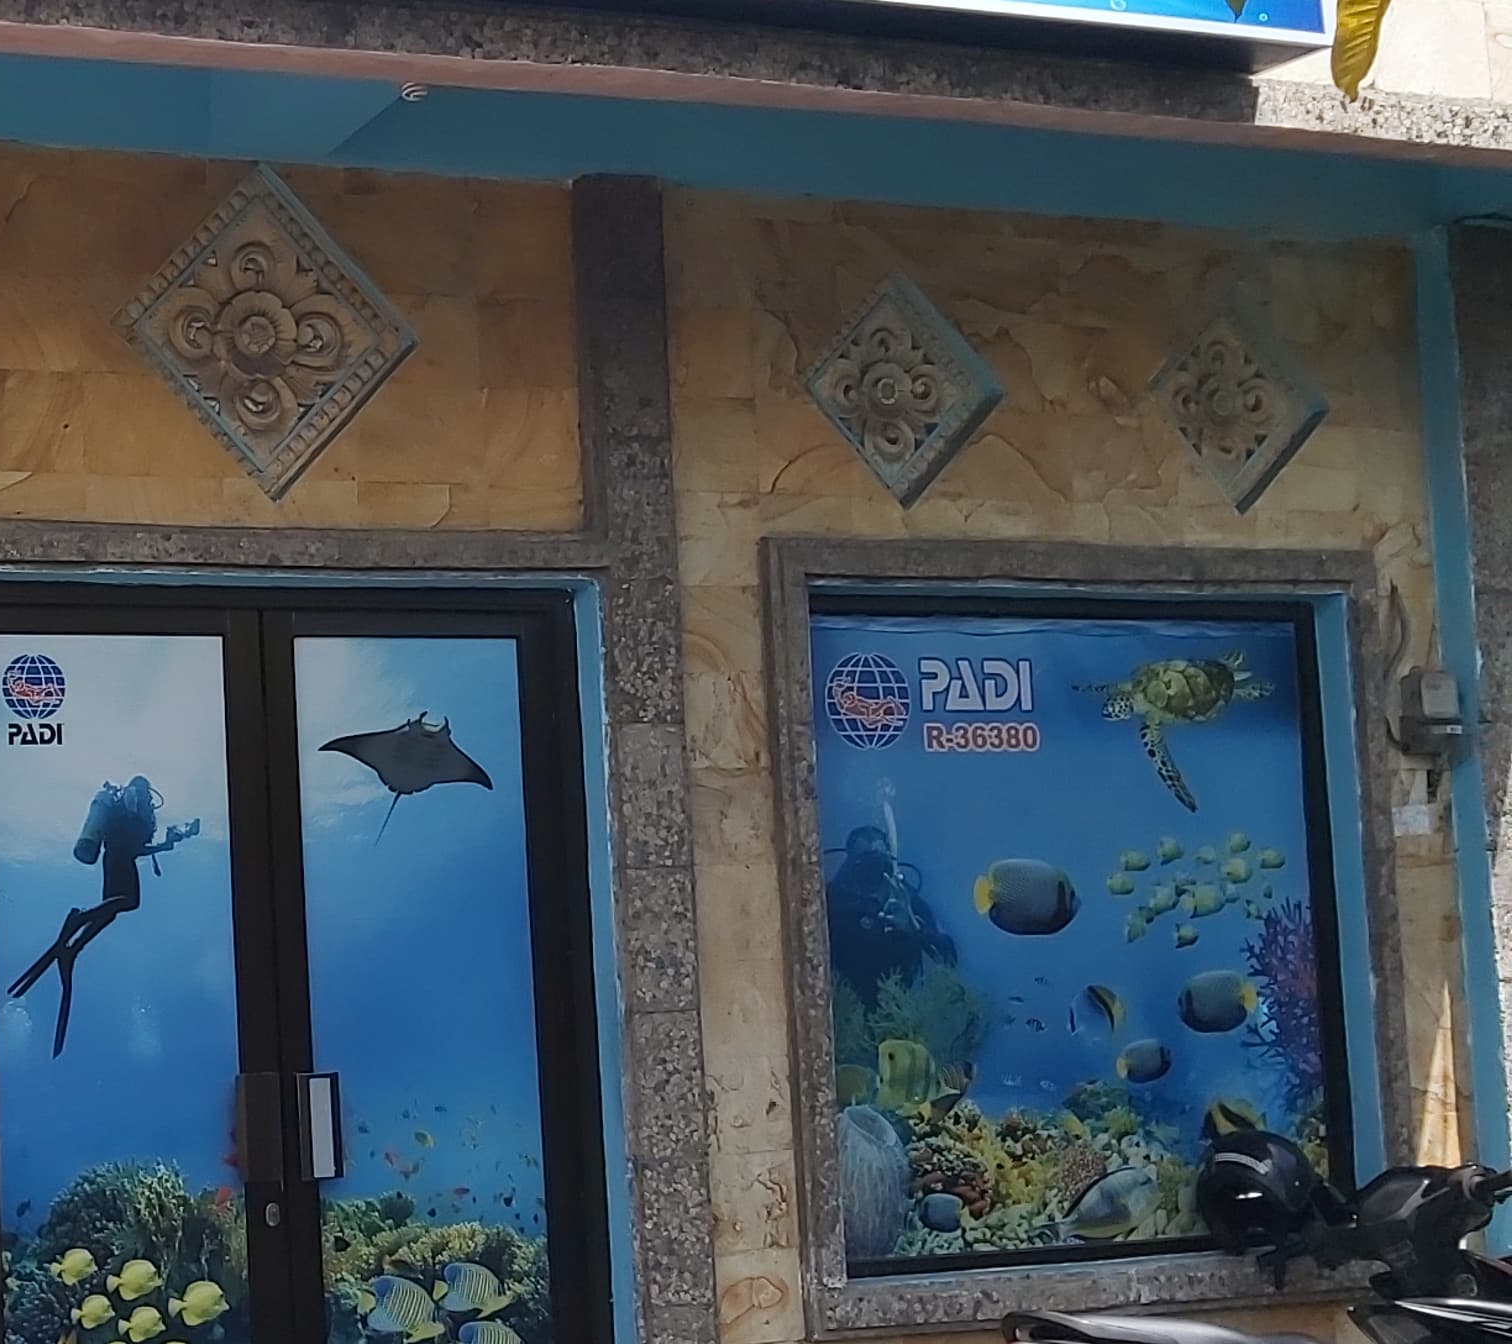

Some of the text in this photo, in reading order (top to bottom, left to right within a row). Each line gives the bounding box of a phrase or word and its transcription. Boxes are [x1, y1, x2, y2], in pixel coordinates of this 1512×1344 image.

[918, 658, 1034, 712] PADI
[7, 722, 64, 746] PADI
[924, 722, 1041, 753] R-36380
